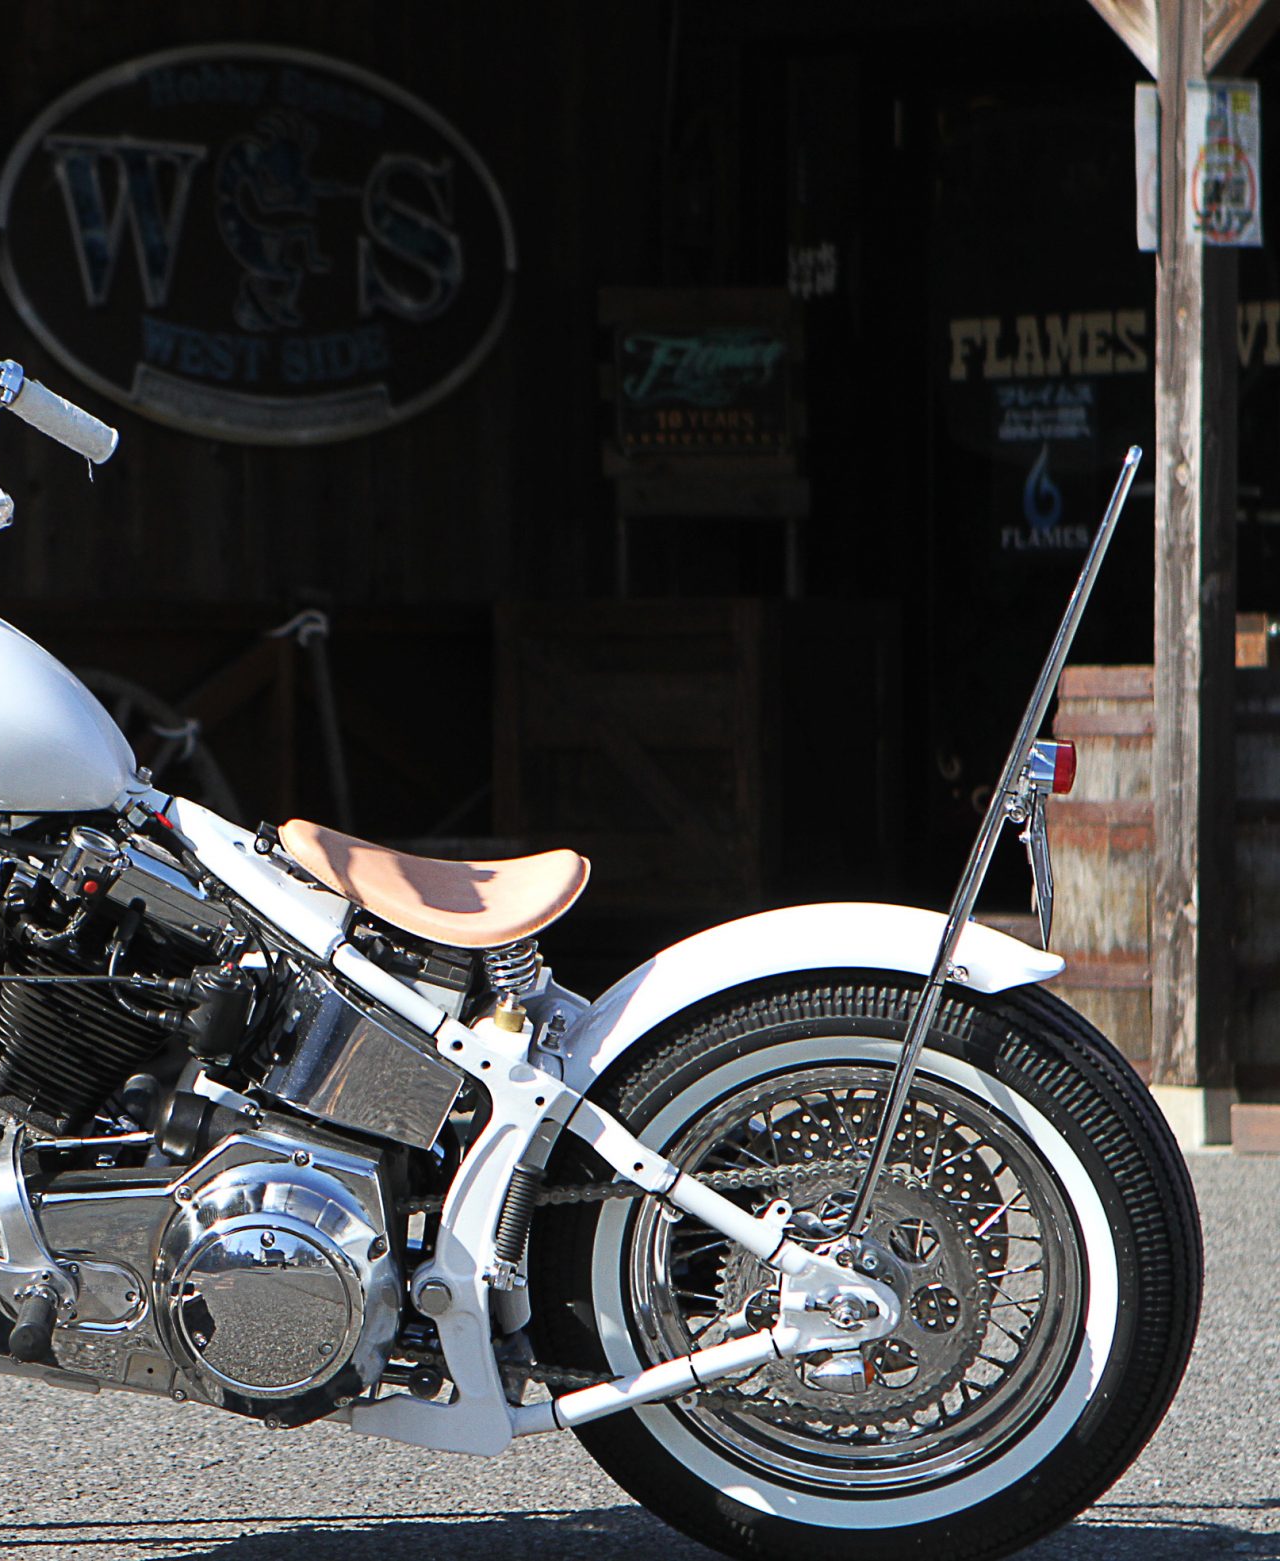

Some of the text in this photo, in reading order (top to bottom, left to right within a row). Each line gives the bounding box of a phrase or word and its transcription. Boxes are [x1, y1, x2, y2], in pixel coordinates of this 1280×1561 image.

[146, 64, 270, 109] Hobby
[41, 133, 208, 309] W
[357, 151, 465, 325] S
[142, 316, 392, 383] WEST SIDE
[949, 309, 1149, 381] FLAMES
[656, 409, 756, 432] 10 YEARS
[1000, 526, 1089, 551] FLAMES
